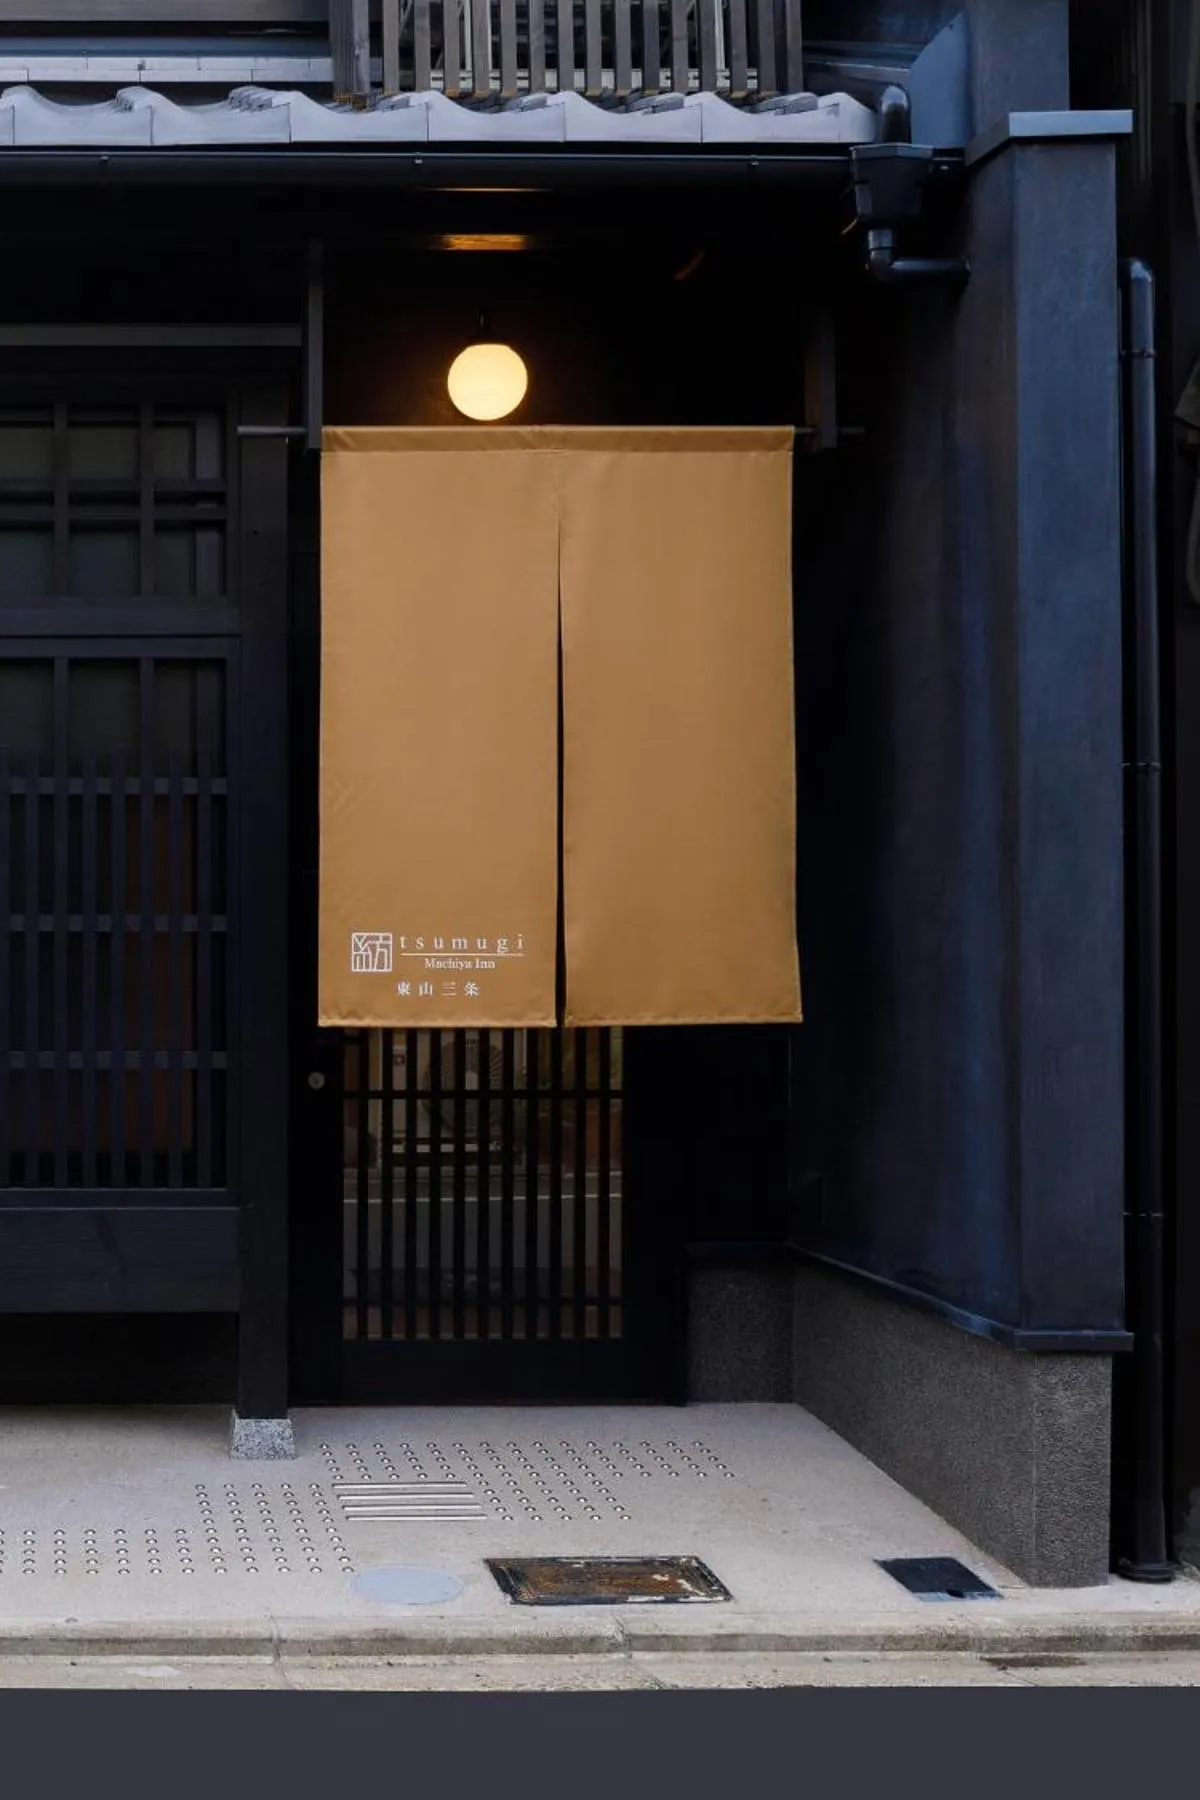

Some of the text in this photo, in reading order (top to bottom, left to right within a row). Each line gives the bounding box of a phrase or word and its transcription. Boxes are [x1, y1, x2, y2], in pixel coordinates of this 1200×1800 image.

[400, 933, 524, 954] tsumugi
[424, 957, 496, 970] Machiya Inn
[397, 981, 480, 997] 東山三条
